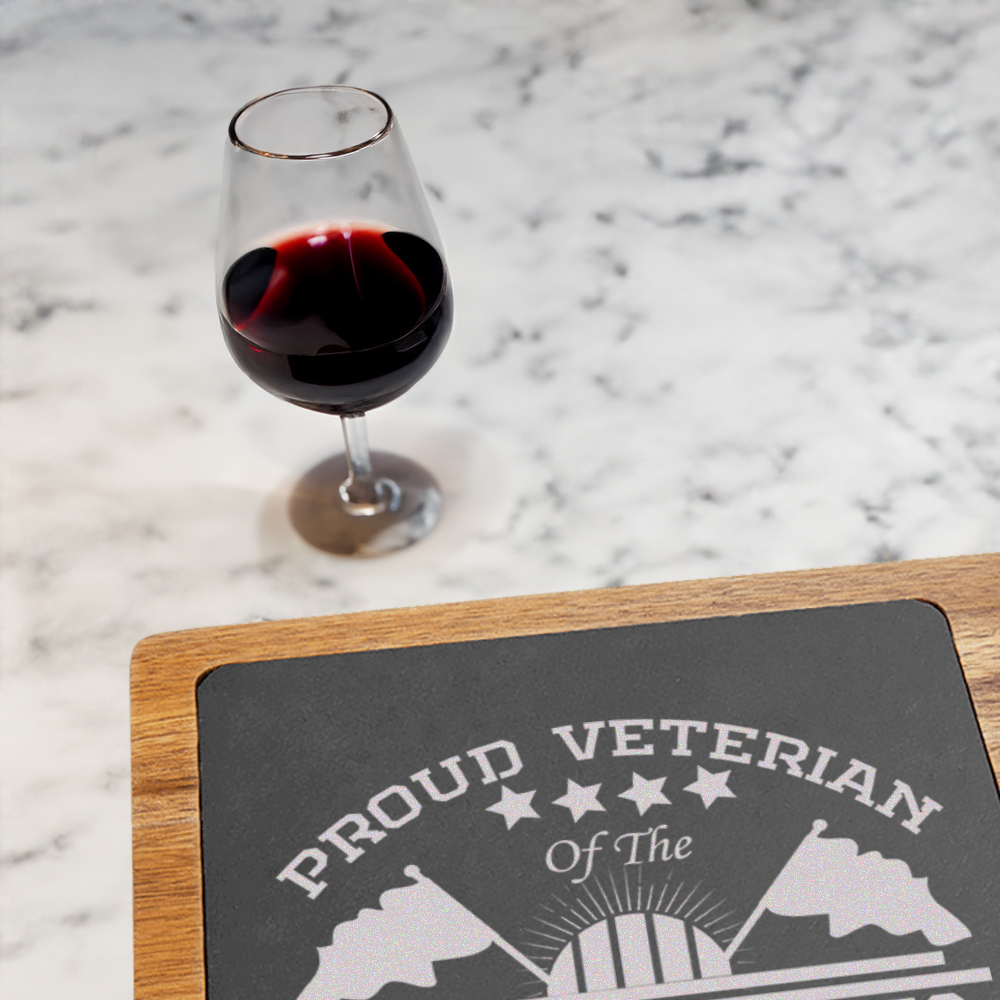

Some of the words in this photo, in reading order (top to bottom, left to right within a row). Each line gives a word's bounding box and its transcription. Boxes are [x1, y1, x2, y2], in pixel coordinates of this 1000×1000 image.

[276, 739, 525, 901] PROUD
[551, 718, 943, 835] VETERIAN
[545, 829, 608, 883] Of
[614, 824, 693, 867] The
